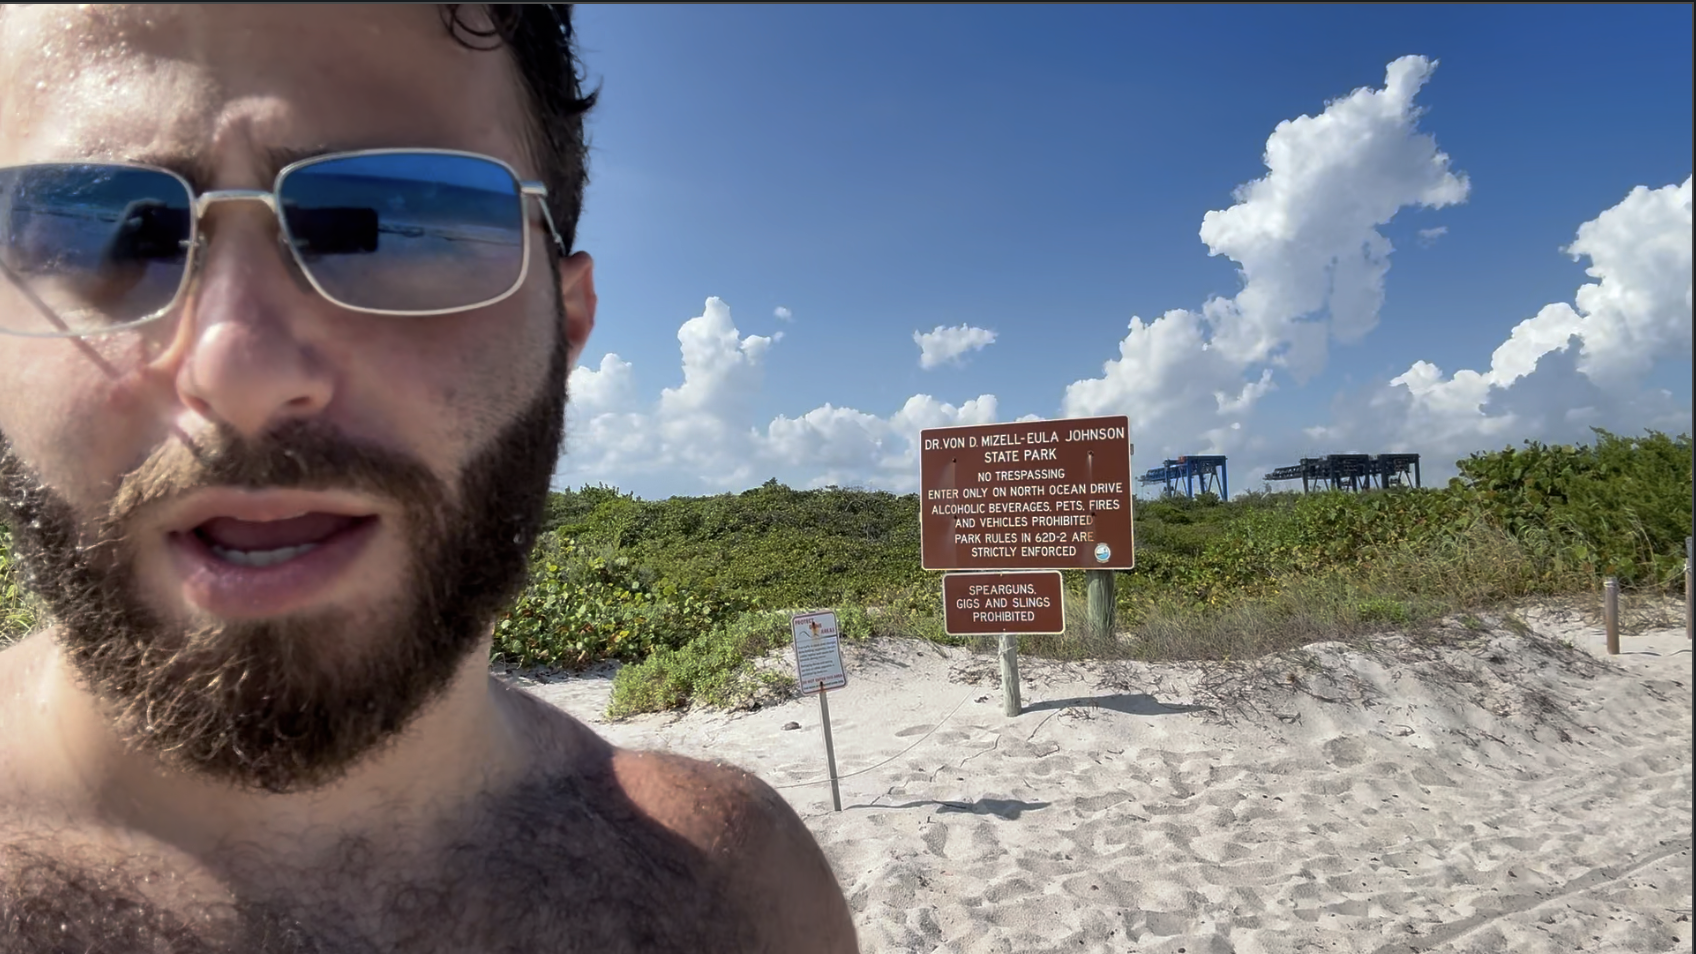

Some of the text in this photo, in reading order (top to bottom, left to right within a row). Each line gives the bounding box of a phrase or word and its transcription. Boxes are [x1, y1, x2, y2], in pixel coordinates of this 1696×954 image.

[981, 431, 1059, 446] MIZELL-EULA
[1065, 427, 1124, 442] JOHNSON
[985, 448, 1057, 463] STATE PARK
[978, 468, 1065, 482] NO TRESPASSING
[928, 483, 1122, 499] ENTER ONLY ON NORTH OCEAN DRIVE
[932, 503, 985, 514] ALCOHOLIC
[1089, 499, 1120, 510] FIRES
[954, 515, 1093, 528] AND VEHICLES PROHIBITED
[955, 532, 1094, 544] PARK RULES IN 62D-2 ARE
[972, 546, 1076, 557] STRICTLY ENFORCED
[957, 597, 1050, 609] GIGS AND SLINGS
[973, 611, 1034, 622] PROHIBITED
